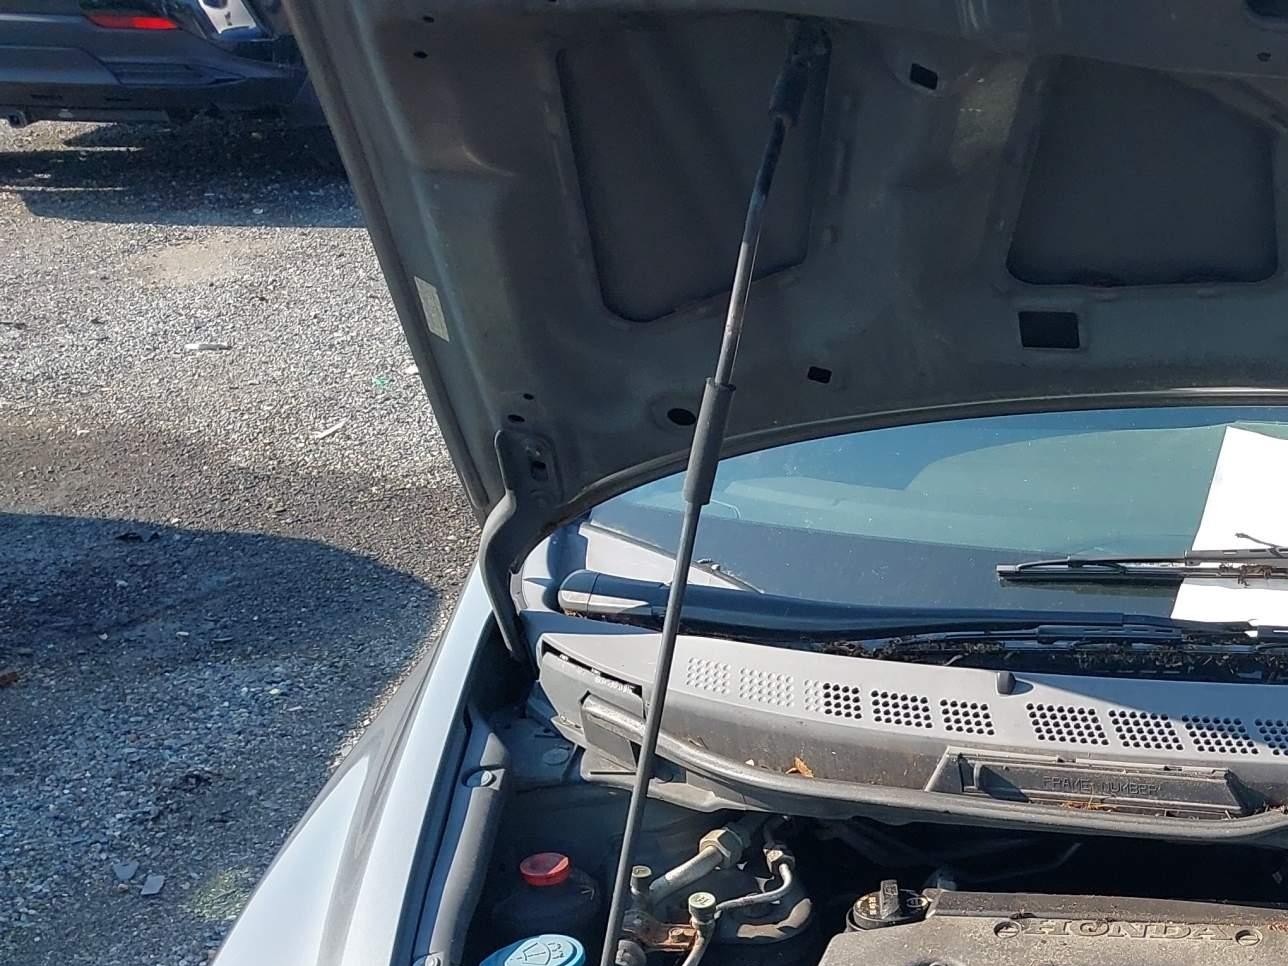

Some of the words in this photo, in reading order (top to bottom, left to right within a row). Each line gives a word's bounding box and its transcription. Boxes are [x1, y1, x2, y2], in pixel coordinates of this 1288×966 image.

[1043, 775, 1089, 793] FRAME
[1101, 782, 1160, 796] NUMBER
[1023, 920, 1233, 941] HONDA
